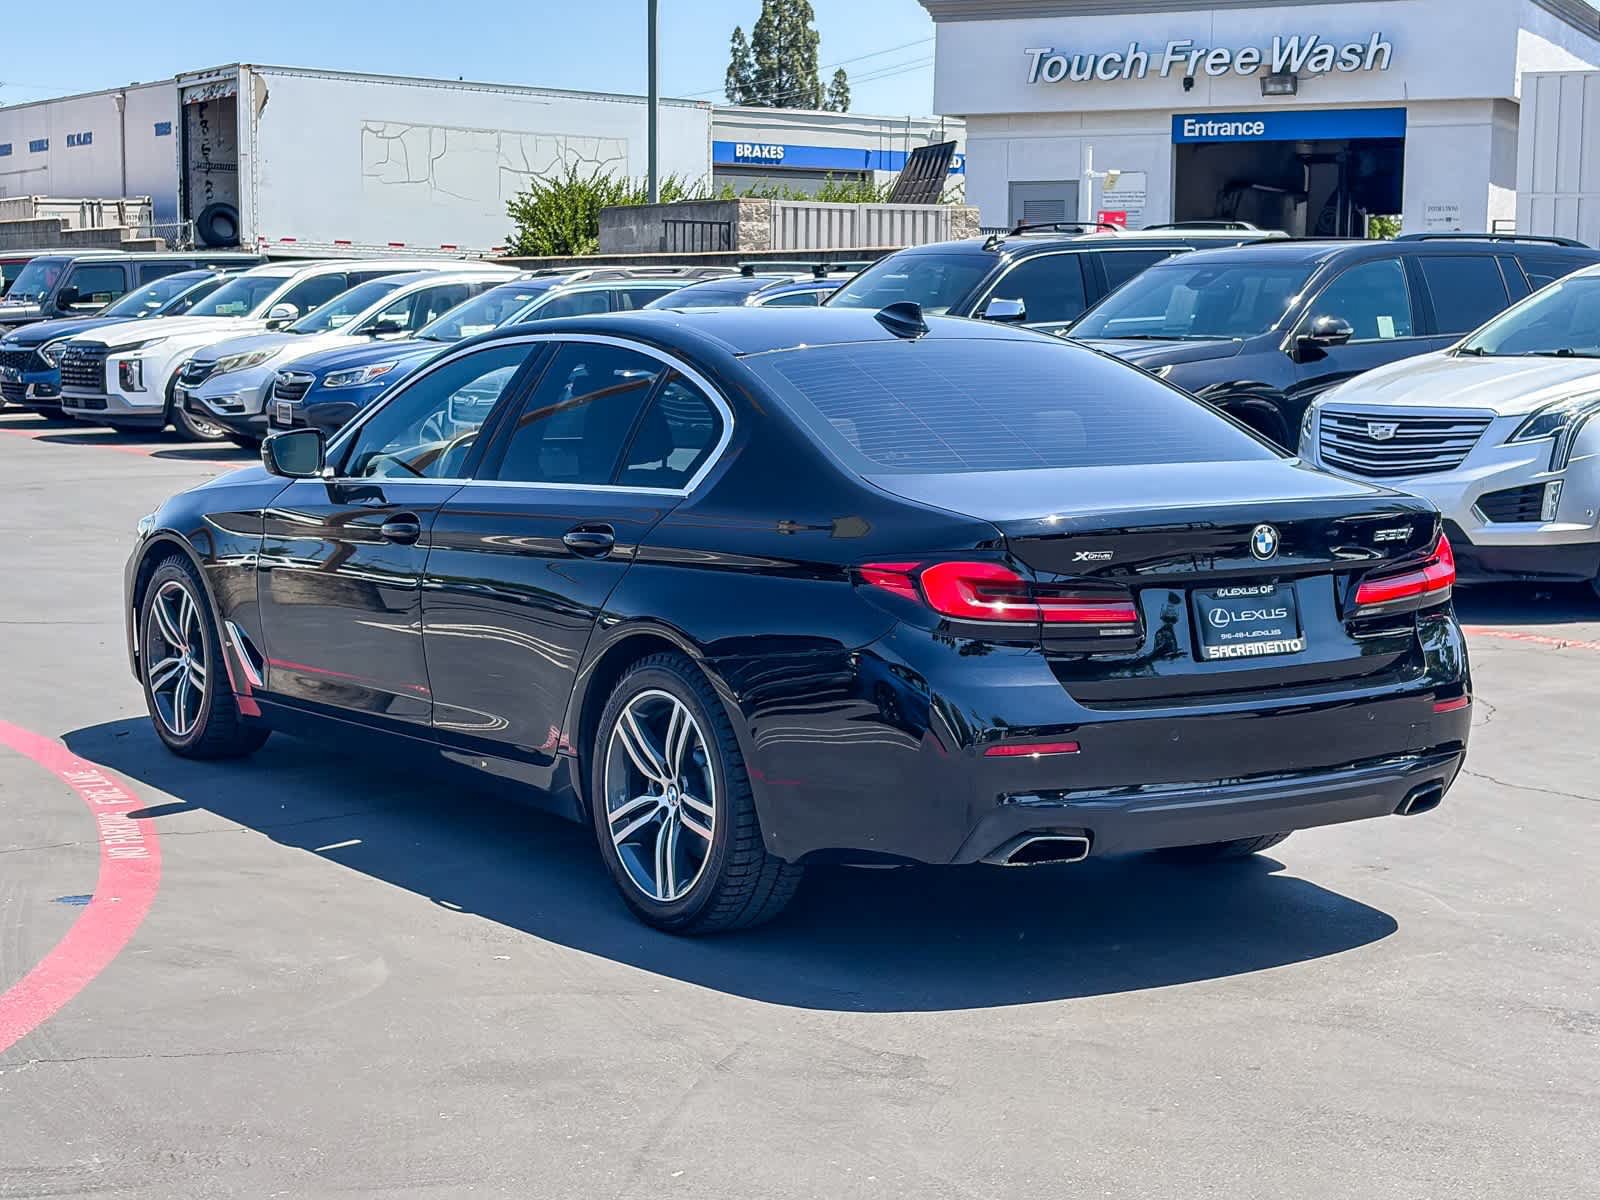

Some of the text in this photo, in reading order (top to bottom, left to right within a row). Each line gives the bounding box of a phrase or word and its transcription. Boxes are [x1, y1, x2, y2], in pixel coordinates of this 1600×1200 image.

[1023, 31, 1393, 84] Touch Free Wash
[1183, 117, 1265, 138] Entrance
[735, 143, 785, 159] BRAKES
[1225, 585, 1274, 596] LEXUS OF
[1231, 607, 1288, 622] LEXUS
[1209, 639, 1302, 659] SACRAMENTO
